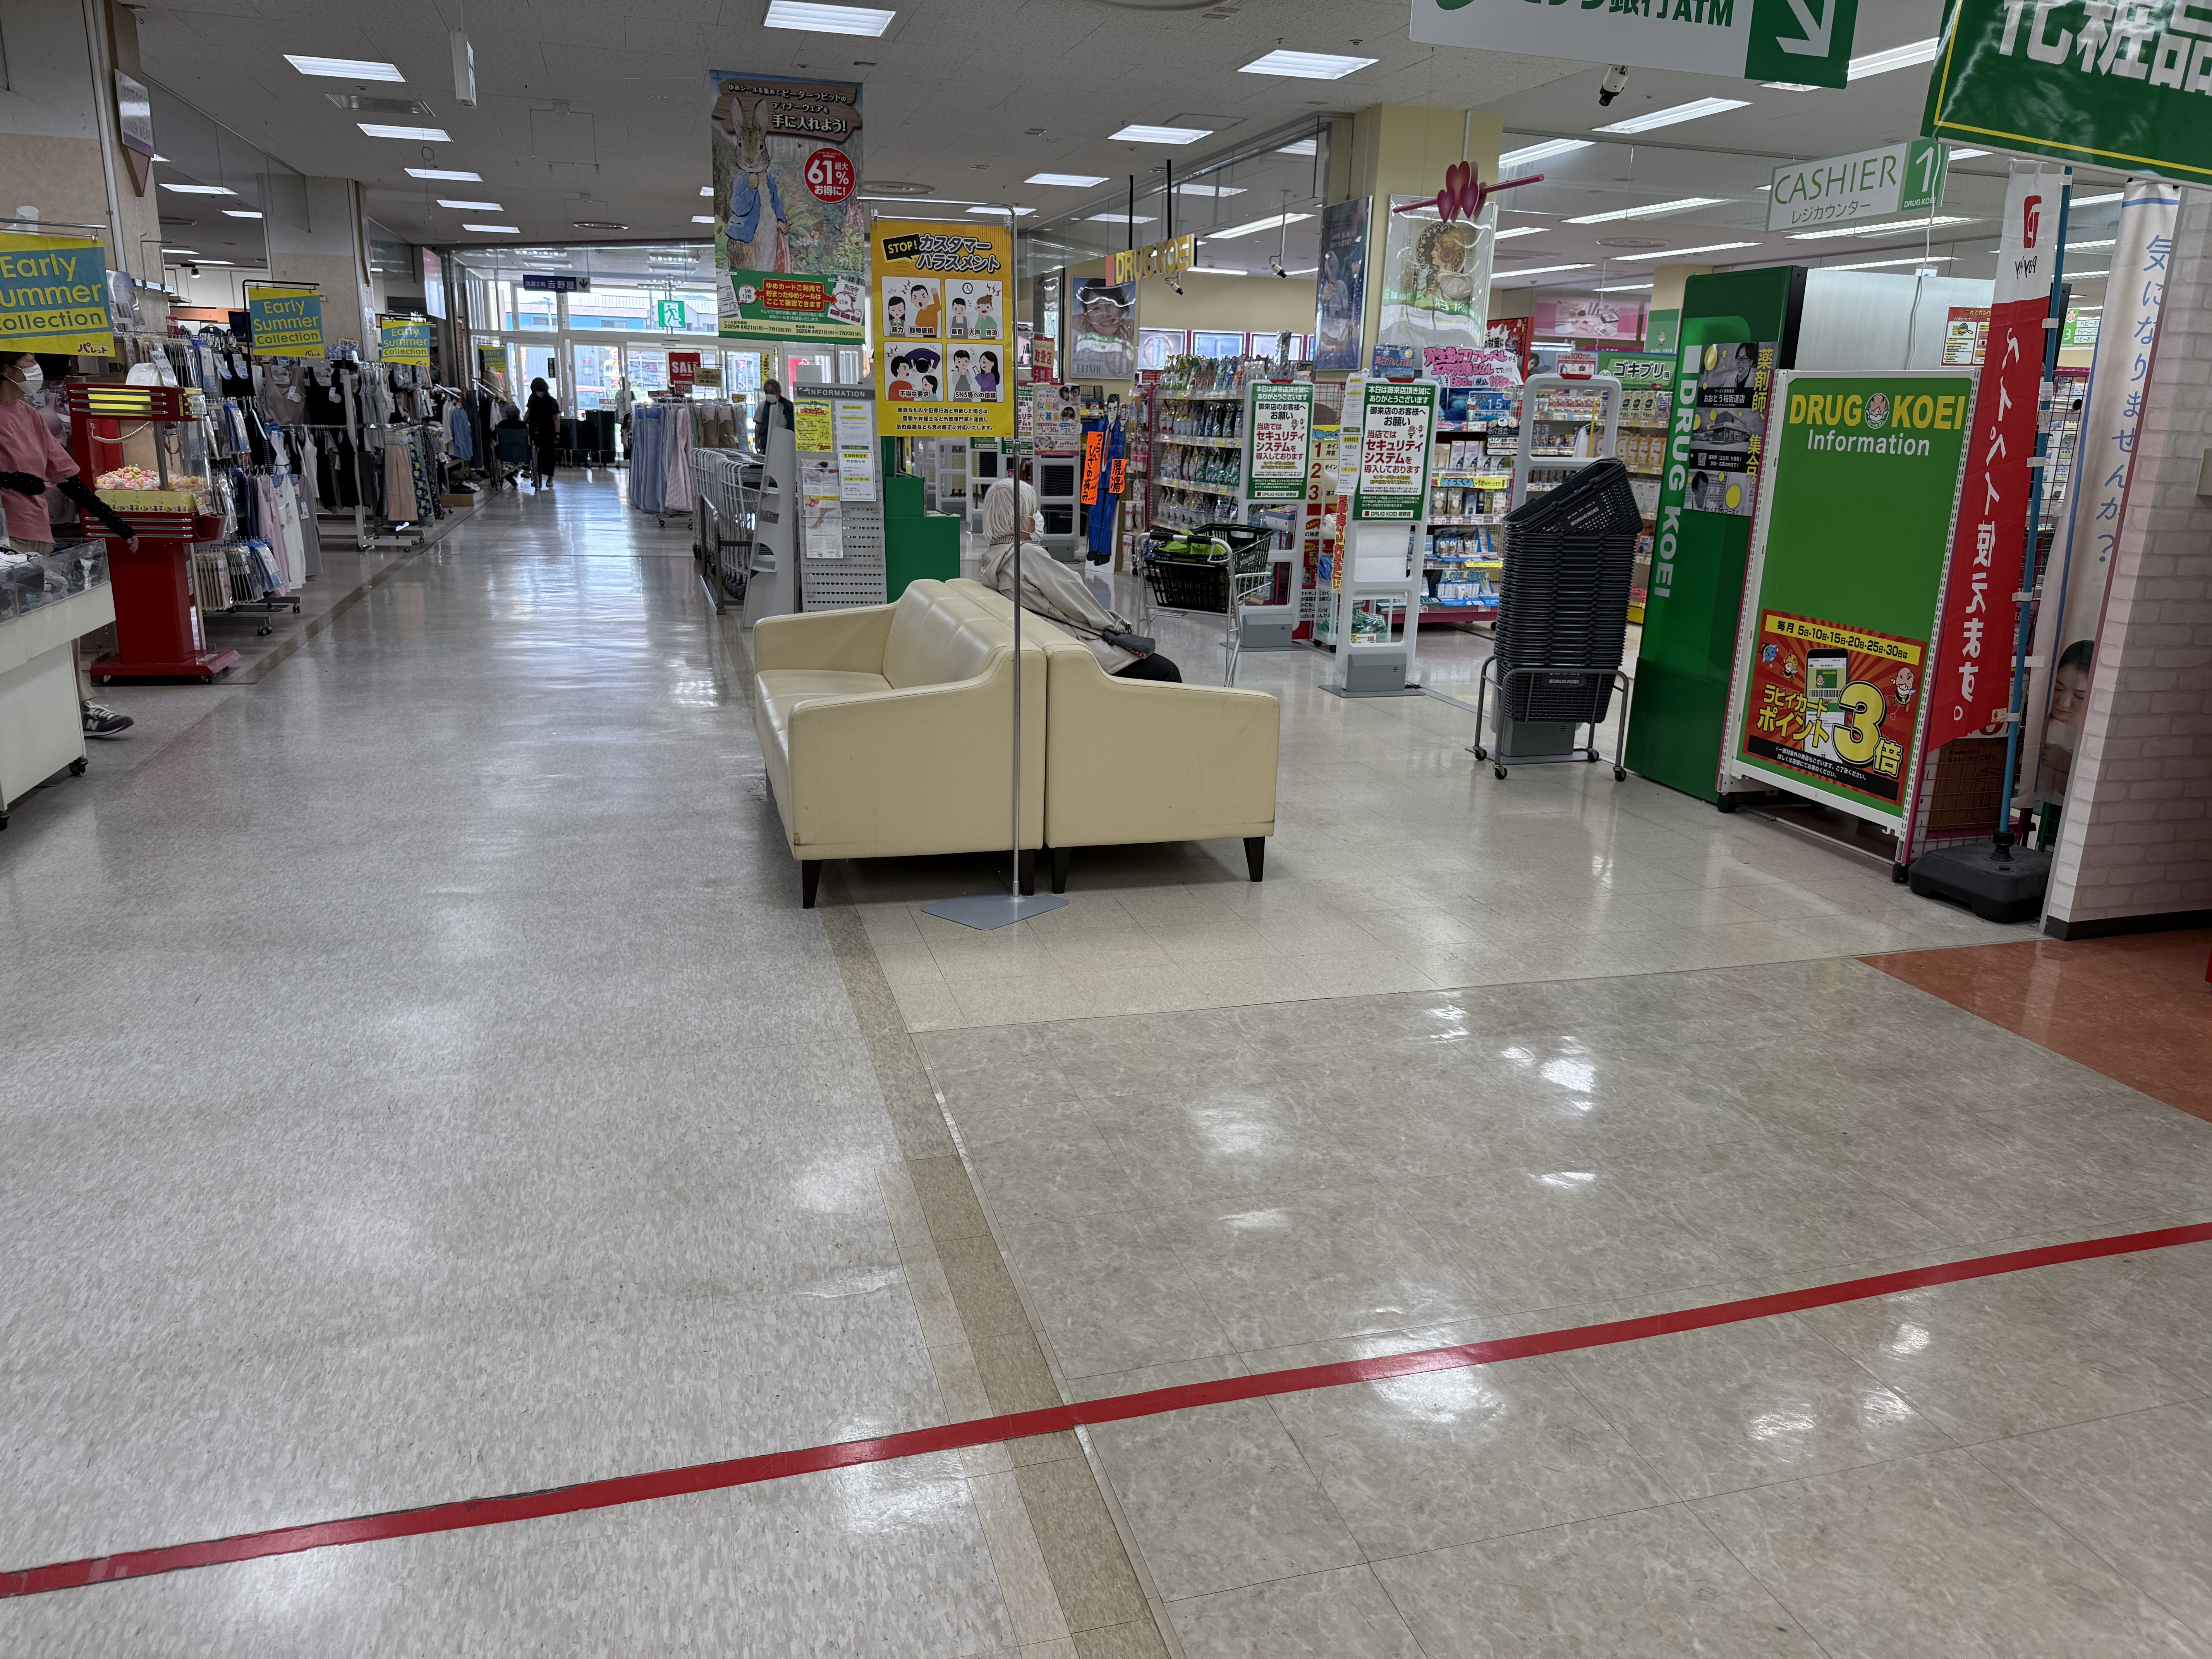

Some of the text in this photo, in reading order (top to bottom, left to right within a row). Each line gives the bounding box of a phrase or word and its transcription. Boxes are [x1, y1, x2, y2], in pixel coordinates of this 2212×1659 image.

[772, 101, 829, 113] ディナーウェアを
[771, 114, 847, 132] 手に入れよう!
[1915, 146, 1934, 192] 1
[1775, 155, 1896, 204] CASHIER
[815, 185, 845, 196] お得に!
[1904, 199, 1921, 208] DRUG
[1792, 200, 1870, 224] レジカウンター
[888, 239, 918, 254] STOP!
[919, 234, 992, 253] カスタマー
[916, 253, 1001, 273] ハラスメント
[1116, 234, 1195, 284] DRUG KOEI
[0, 254, 76, 282] Early
[547, 280, 575, 290] 吉野屋
[766, 282, 821, 291] ゆめカードご利用で
[0, 284, 101, 307] ummer
[766, 290, 821, 300] 貯まったゆめシールは
[263, 299, 305, 316] Early
[767, 299, 821, 308] ここで確認できます
[0, 311, 102, 330] ollection
[254, 316, 318, 332] Summer
[257, 331, 318, 344] Collection
[392, 327, 419, 338] Early
[2064, 328, 2071, 340] 3
[78, 342, 108, 354] パレット
[384, 338, 428, 347] Summer
[1077, 364, 1101, 373] ELIXIR
[1613, 359, 1670, 380] ゴキブリ用
[808, 389, 865, 398] INFORMATION
[1368, 386, 1431, 395] 本日は御来店頂き誠に
[1369, 395, 1429, 404] ありがとうございます
[1704, 395, 1745, 403] おおとう桜街道店
[1037, 401, 1060, 411] 似顔絵
[1370, 407, 1426, 415] 御来店のお客様へ
[1038, 412, 1060, 422] 大募集
[1271, 411, 1293, 420] お願い
[1746, 348, 1774, 484] 薬剤師、 集合。
[1789, 395, 1966, 430] DRUG KOEI
[1384, 416, 1410, 427] お願い
[1256, 431, 1305, 441] セキュリティ
[1367, 430, 1397, 438] 当店では
[1256, 442, 1296, 452] システムを
[1366, 439, 1424, 452] セキュリティ
[1808, 429, 1930, 456] Information
[1314, 442, 1322, 458] 1
[1364, 453, 1412, 464] システムを
[1311, 463, 1321, 479] 2
[1364, 465, 1421, 474] 導入しております
[1439, 477, 1475, 488] ANESSA
[1654, 380, 1698, 597] DRUG KOEI
[1309, 485, 1319, 501] 3
[1574, 514, 1588, 524] DRUG
[1777, 620, 1795, 633] 毎月
[1757, 706, 1829, 747] ポイント
